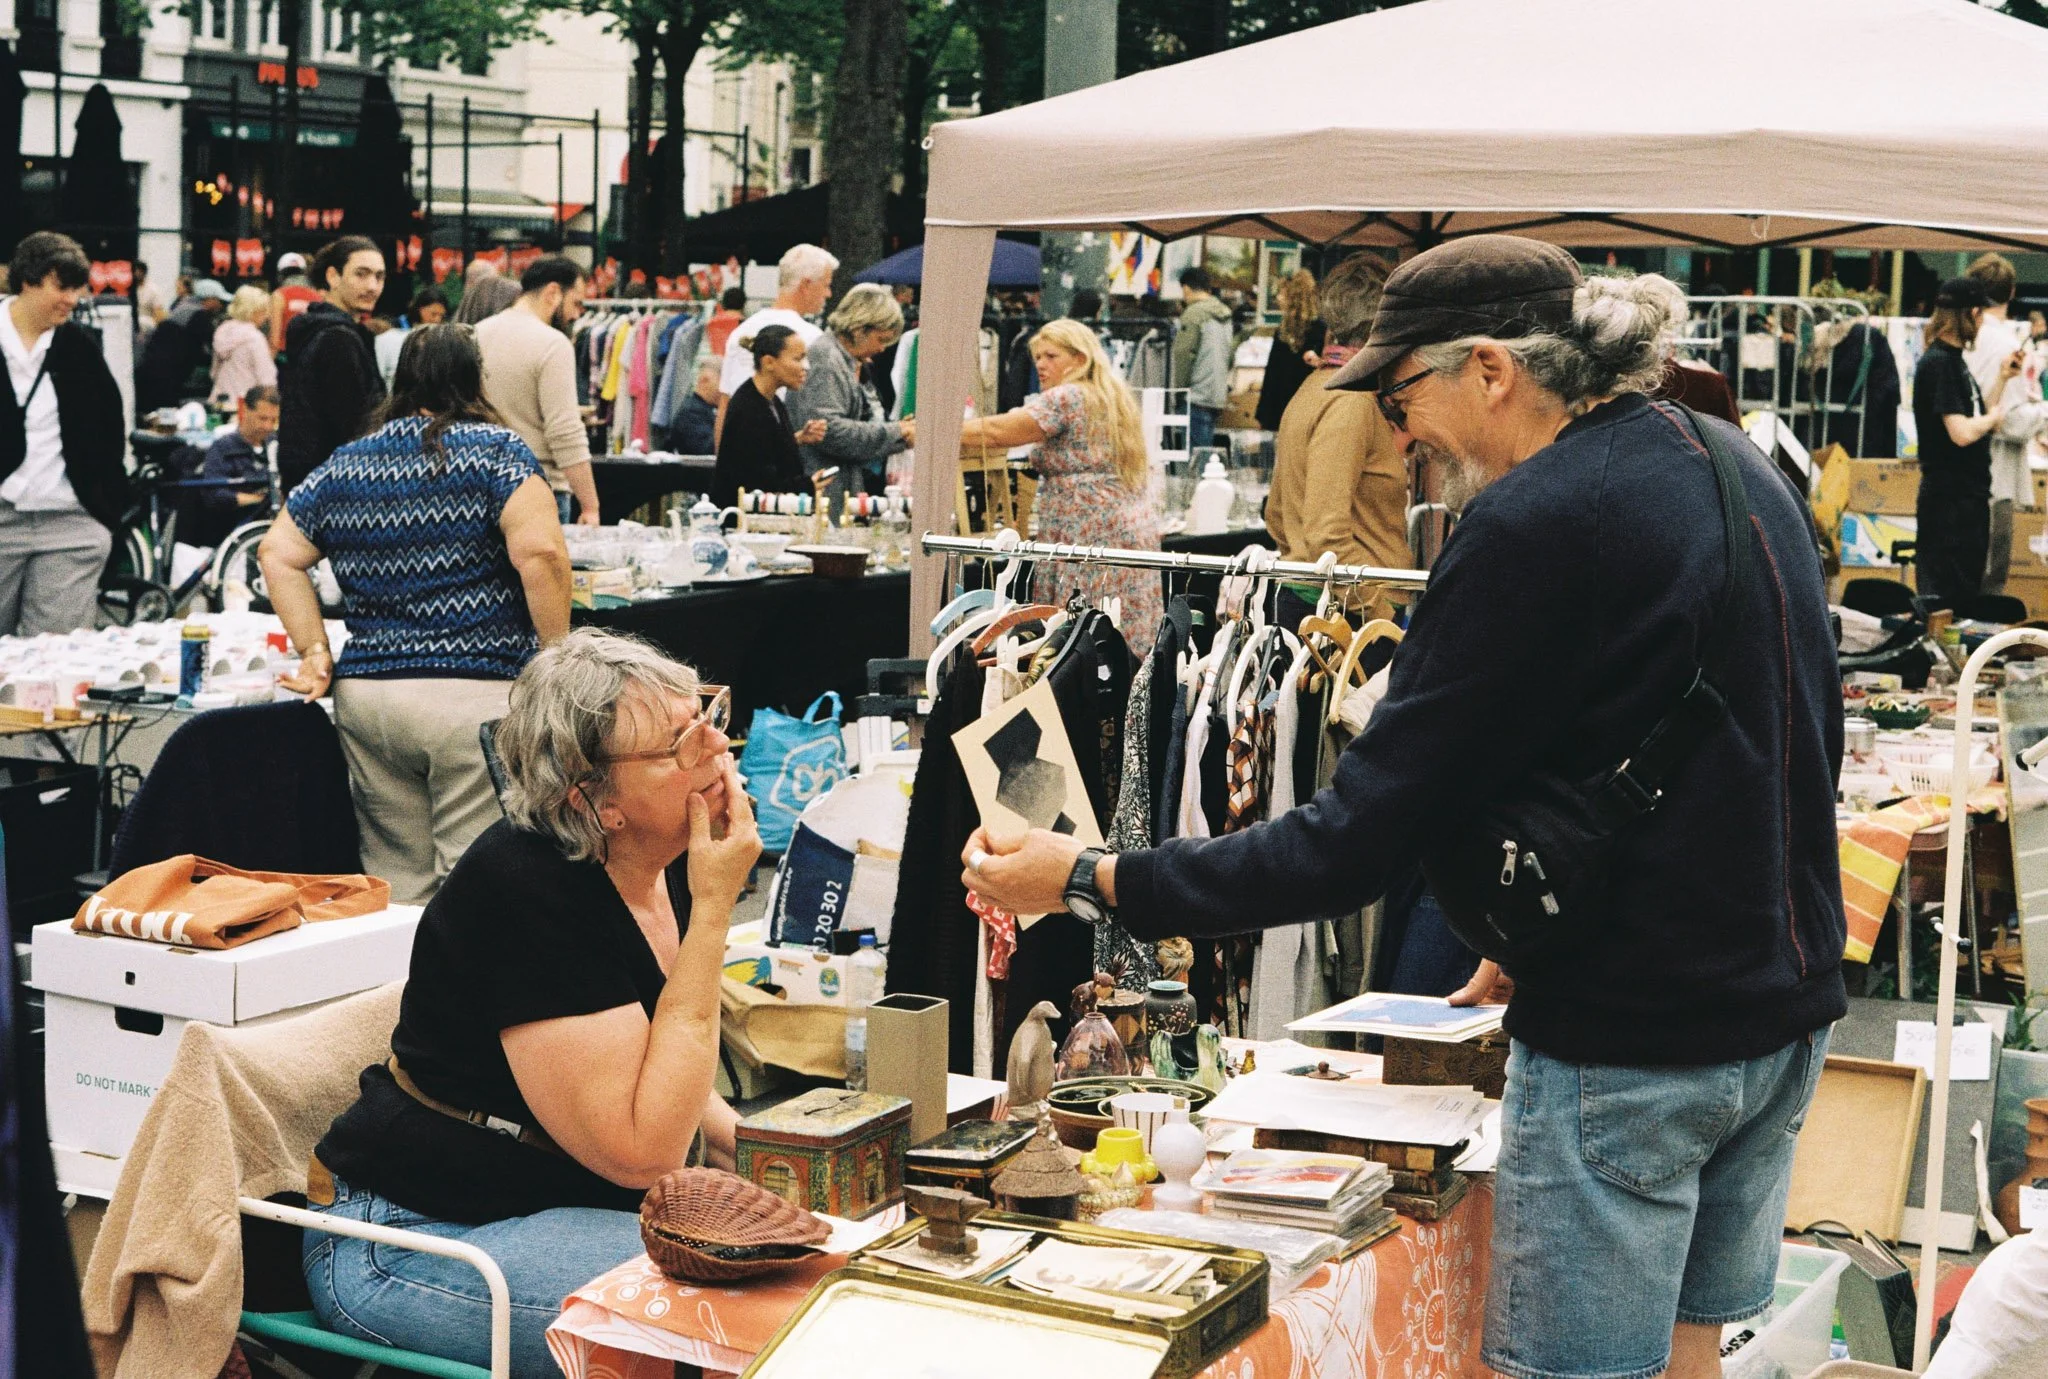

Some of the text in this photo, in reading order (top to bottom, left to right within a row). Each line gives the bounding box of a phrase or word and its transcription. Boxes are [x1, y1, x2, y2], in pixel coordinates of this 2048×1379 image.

[820, 891, 840, 914] 30
[76, 1072, 151, 1099] DO NOT MARK
